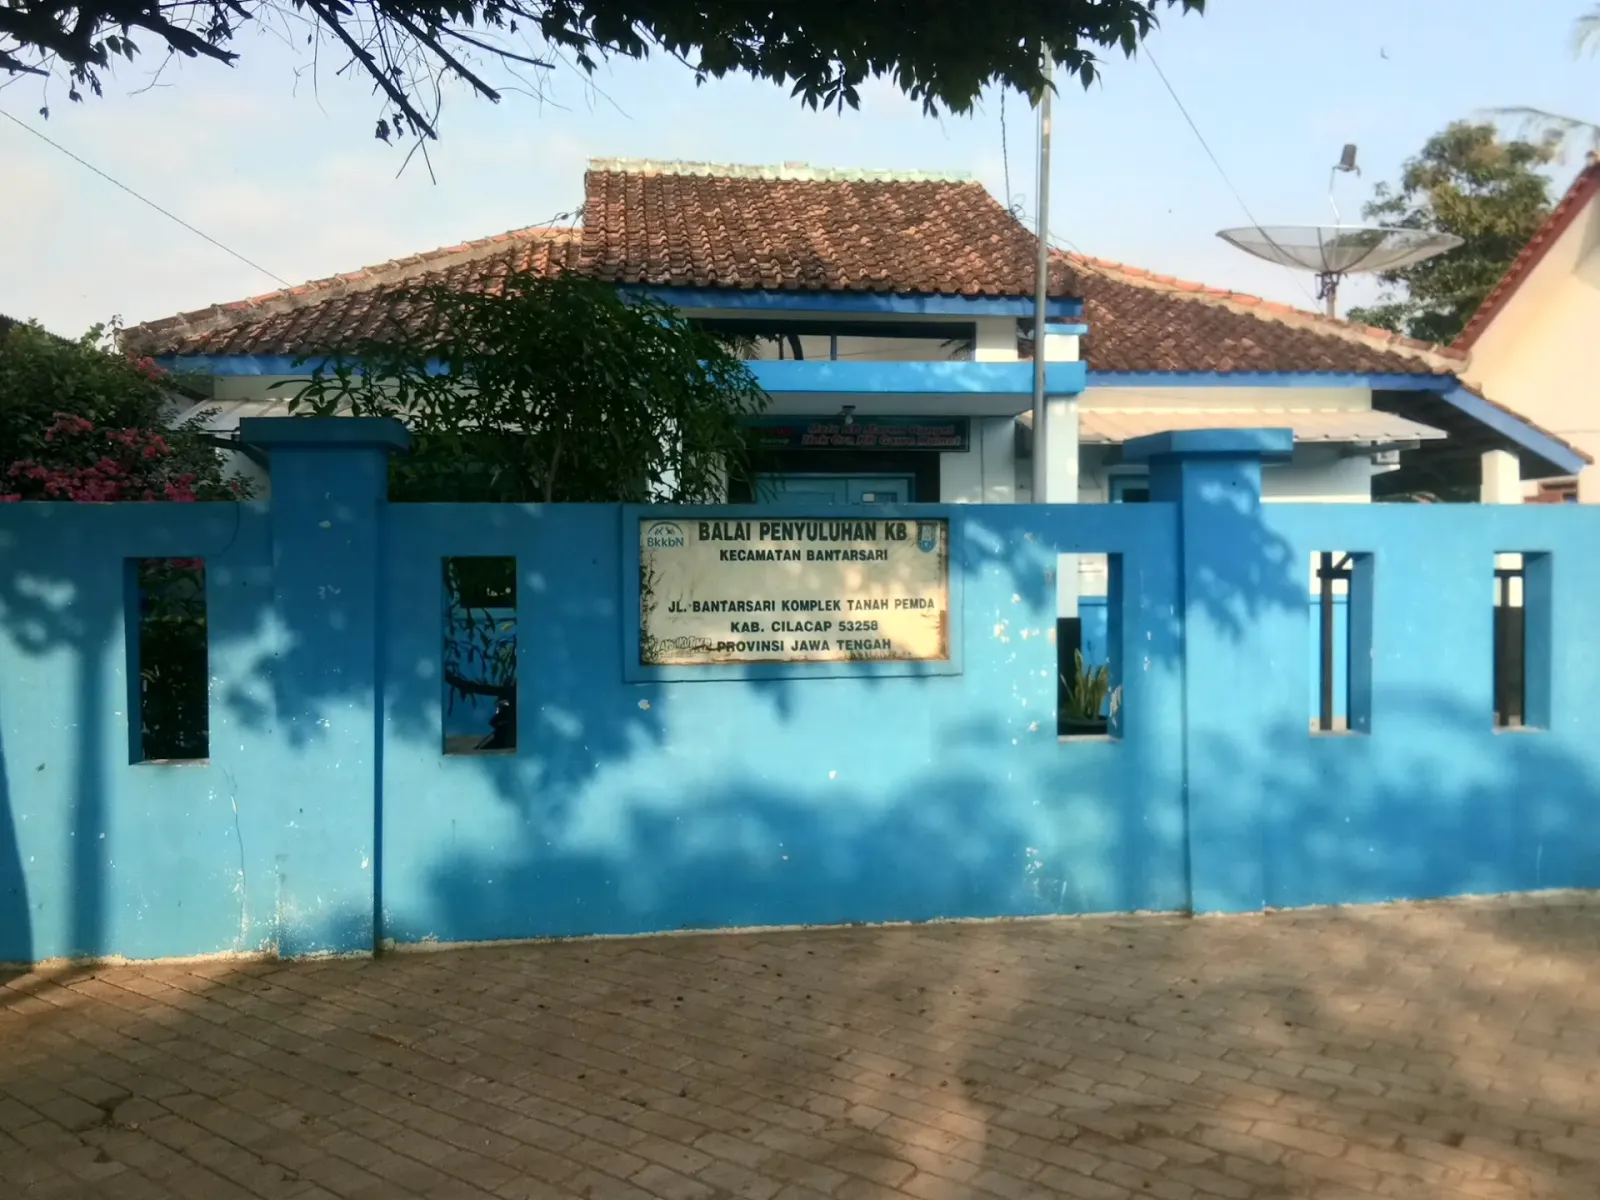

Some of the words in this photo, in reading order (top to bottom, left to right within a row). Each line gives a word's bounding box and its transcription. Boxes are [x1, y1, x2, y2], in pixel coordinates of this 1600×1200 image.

[698, 522, 751, 541] BALAI
[759, 522, 877, 541] PENYULUHAN
[885, 522, 908, 541] KB
[647, 537, 684, 548] BkkbN
[719, 549, 801, 562] KECAMATAN
[806, 549, 888, 562] BANTARSARI
[667, 601, 687, 613] JL.
[692, 600, 776, 612] BANTARSARI
[781, 599, 842, 612] KOMPLEK
[847, 599, 889, 611] TANAH
[894, 598, 935, 610] PEMDA
[730, 621, 765, 633] KAB.
[771, 620, 832, 633] CILACAP
[838, 620, 879, 632] 53258
[717, 640, 785, 652] PROVINSI
[791, 639, 831, 652] JAWA
[836, 638, 892, 651] TENGAH
